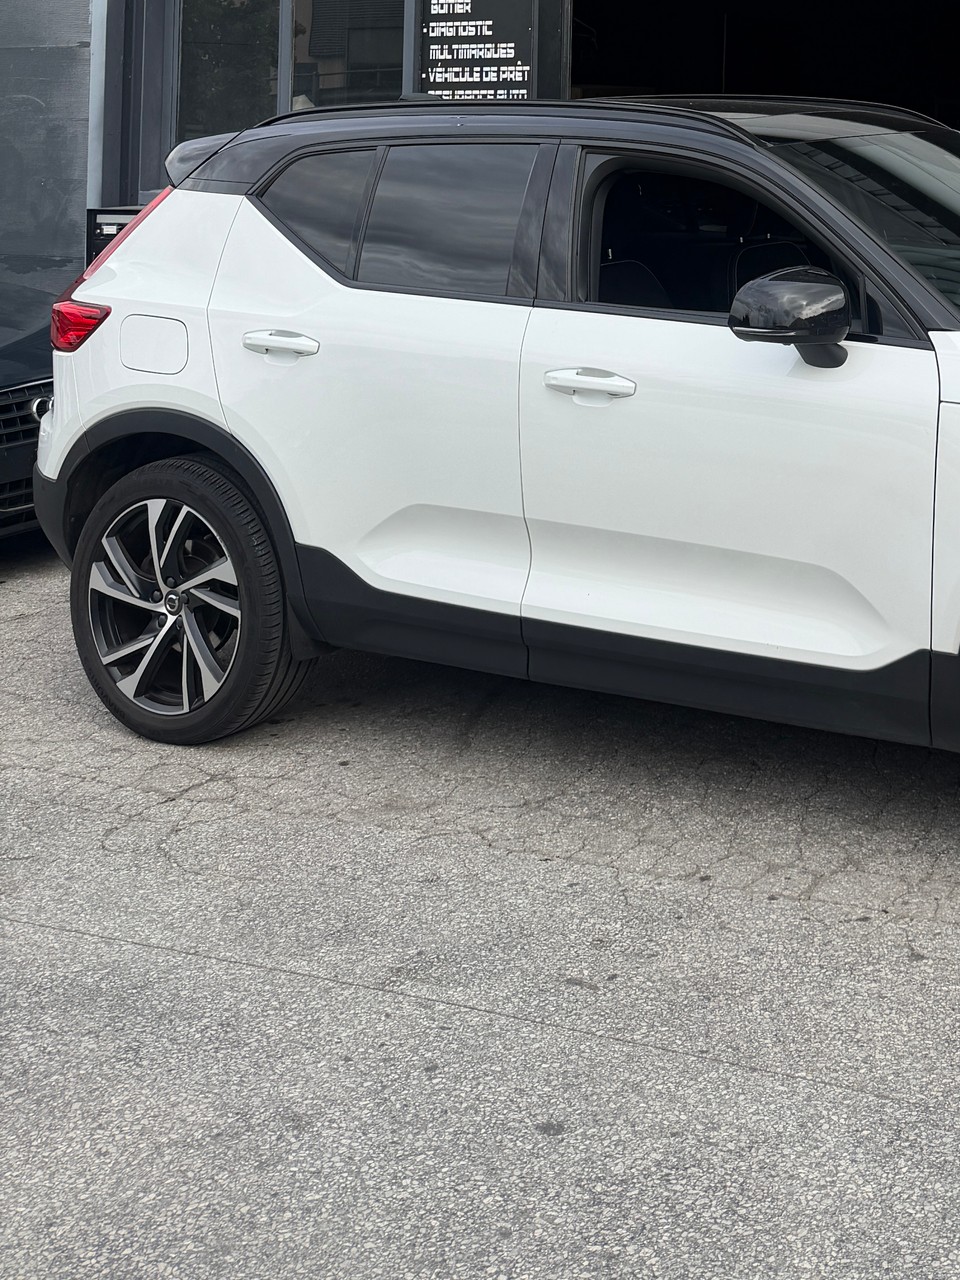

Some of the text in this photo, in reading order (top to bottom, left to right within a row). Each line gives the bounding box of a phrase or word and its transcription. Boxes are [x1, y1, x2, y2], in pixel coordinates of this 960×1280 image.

[429, 20, 493, 37] DIAGNOSTIC
[429, 42, 515, 60] MULTIMARQUES
[428, 60, 531, 83] VÉHICULE DE PRÊT
